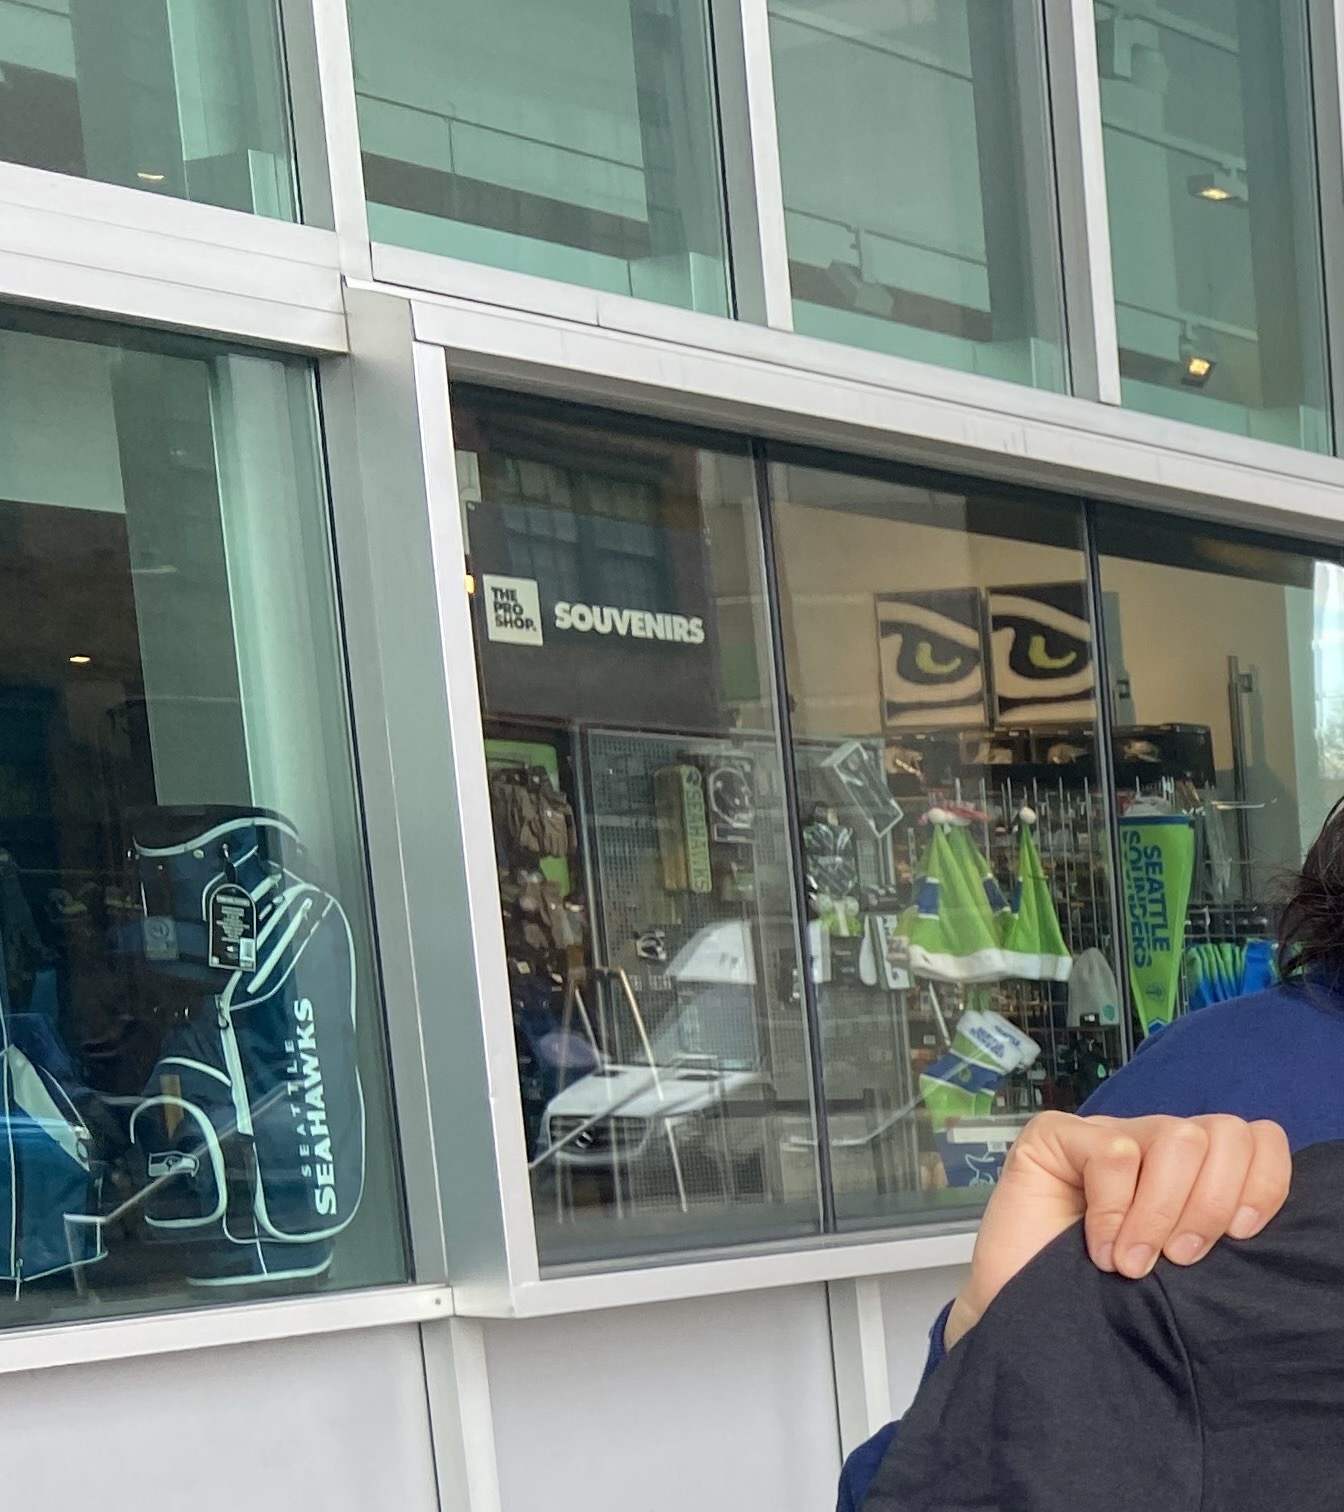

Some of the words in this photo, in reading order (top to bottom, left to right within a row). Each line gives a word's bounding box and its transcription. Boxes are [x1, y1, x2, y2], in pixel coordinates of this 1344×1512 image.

[491, 587, 517, 600] THE
[494, 602, 523, 616] PRO
[555, 601, 704, 644] SOUVENIRS
[1144, 844, 1170, 952] SEATTLE
[285, 1039, 311, 1178] SEATTLE
[295, 997, 337, 1216] SEAHAWKS
